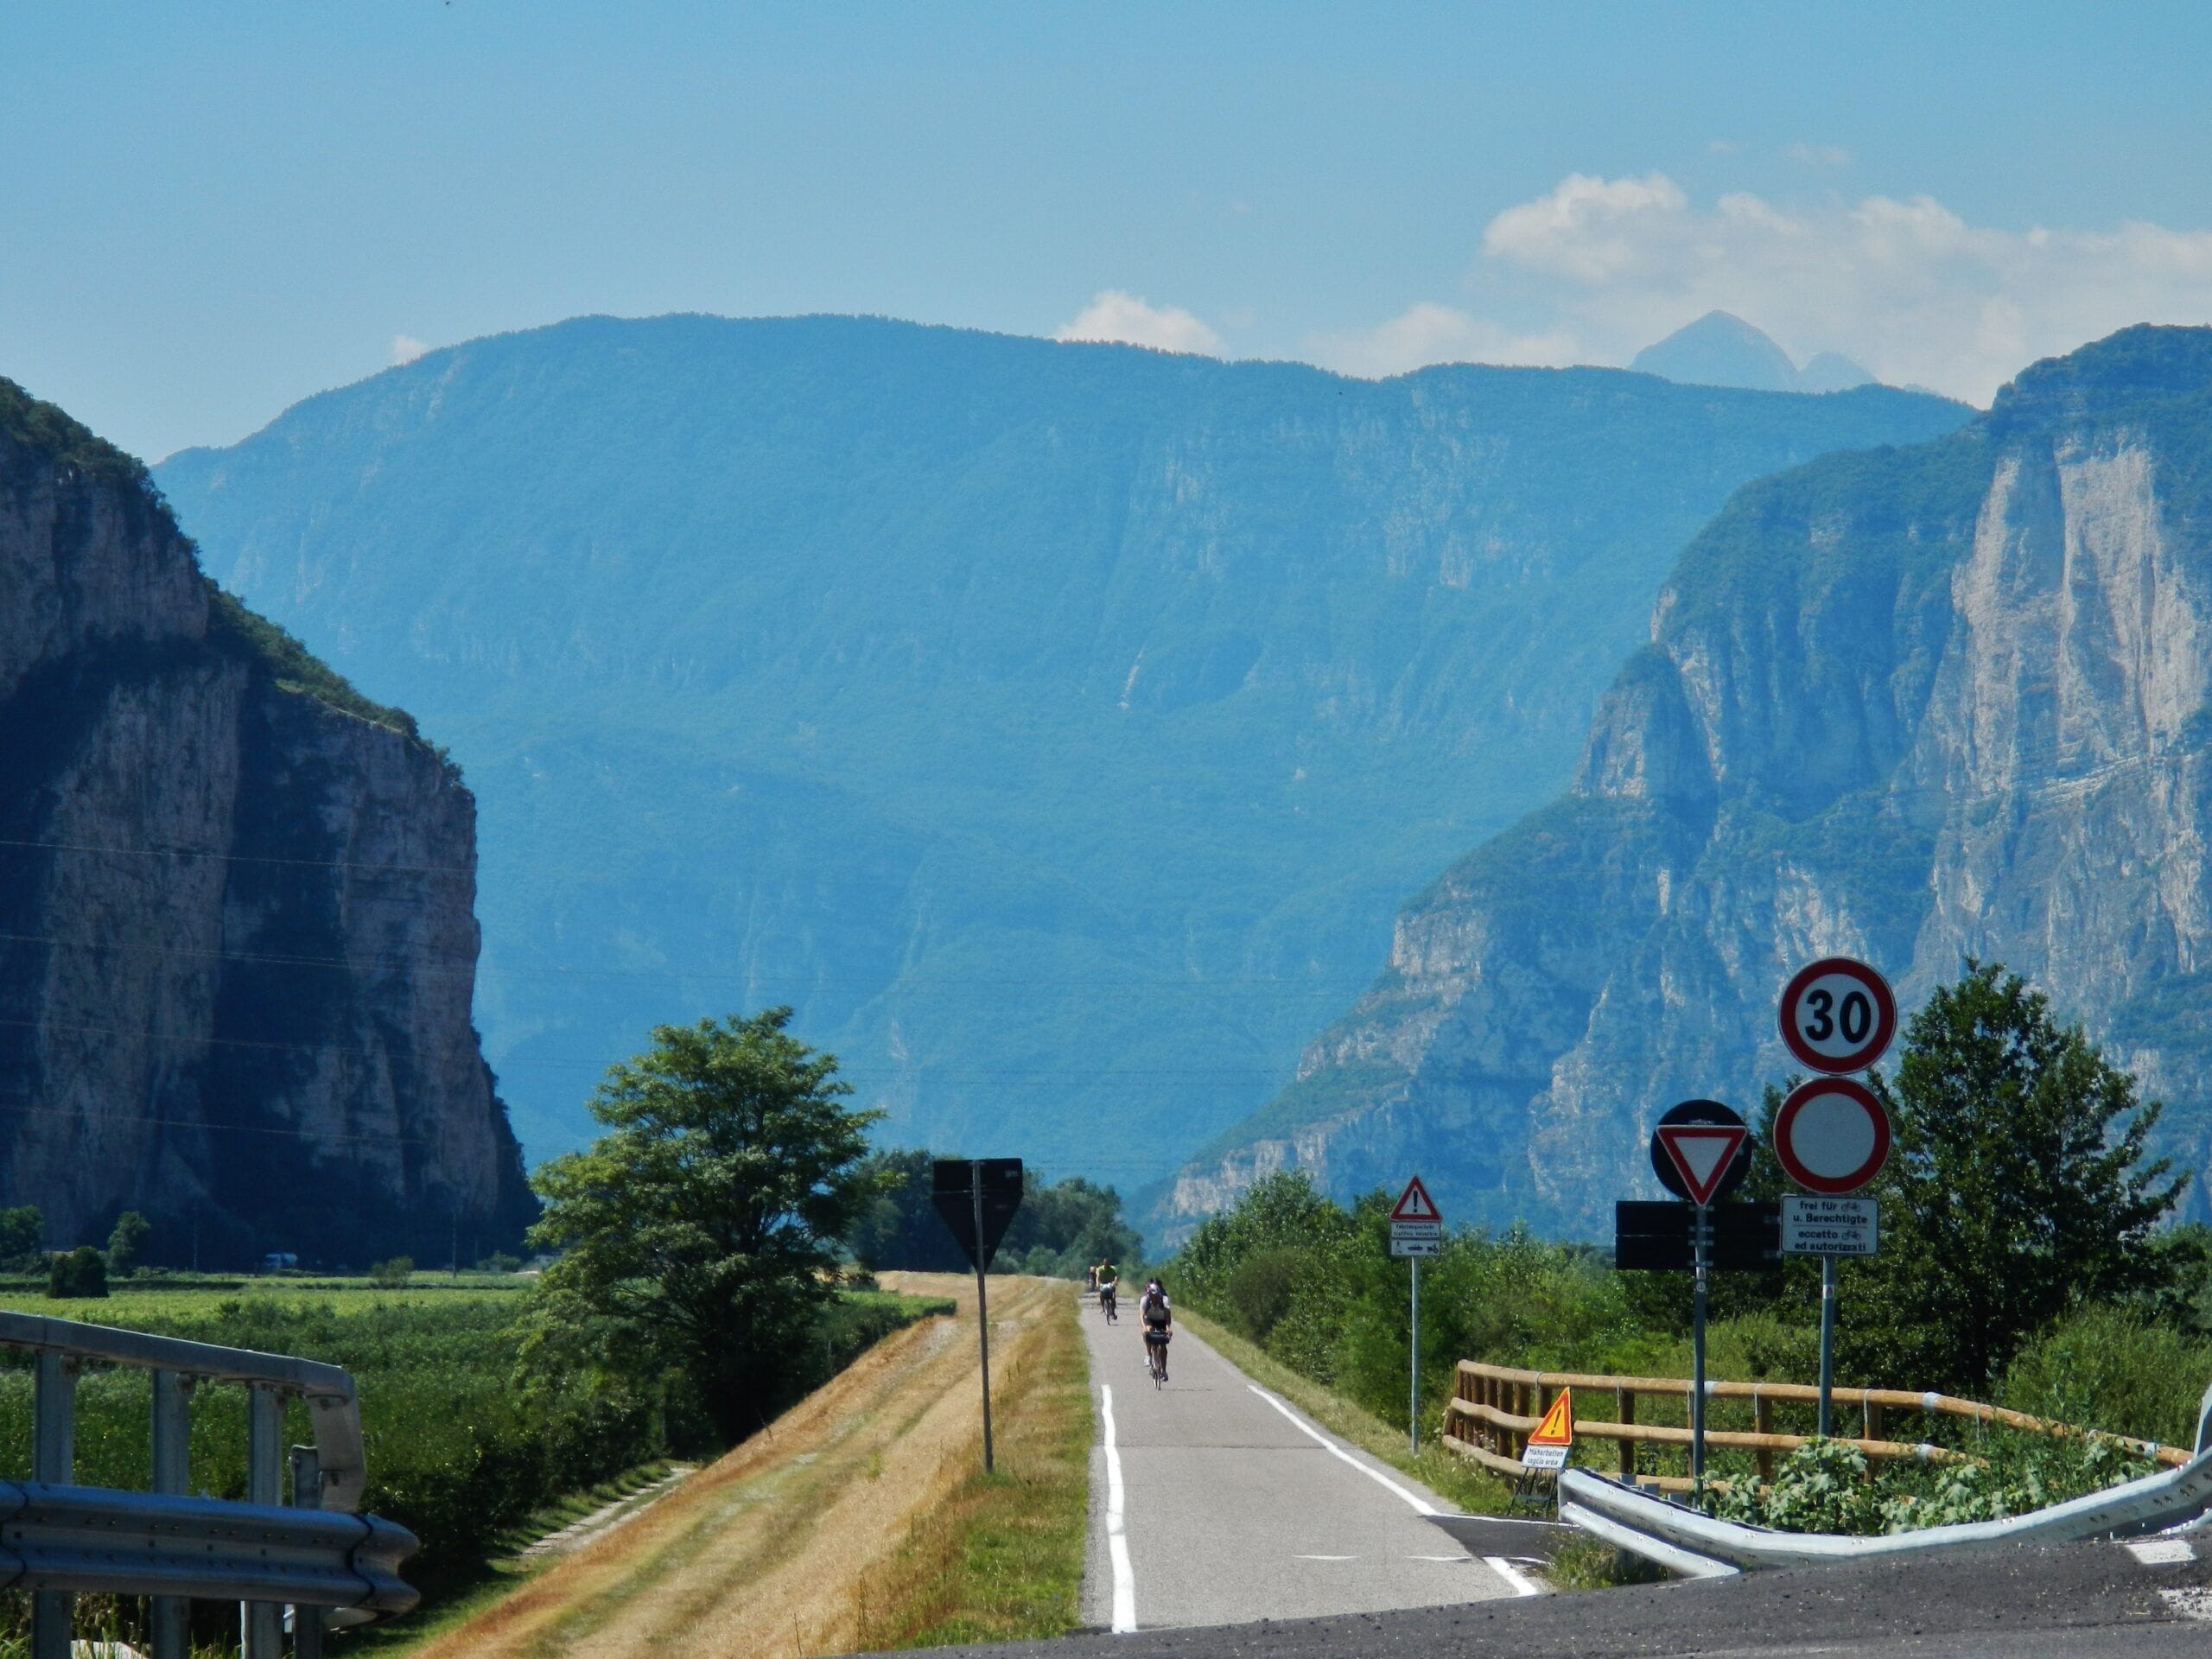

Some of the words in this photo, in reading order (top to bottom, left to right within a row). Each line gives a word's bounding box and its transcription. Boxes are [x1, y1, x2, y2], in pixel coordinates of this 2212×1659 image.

[1805, 989, 1871, 1043] 30
[1799, 1201, 1818, 1210] frei
[1821, 1201, 1838, 1210] für
[1806, 1213, 1867, 1224] Berechtigte
[1798, 1230, 1838, 1239] eccetto
[1794, 1242, 1807, 1250] ed
[1809, 1243, 1866, 1252] autorizzati
